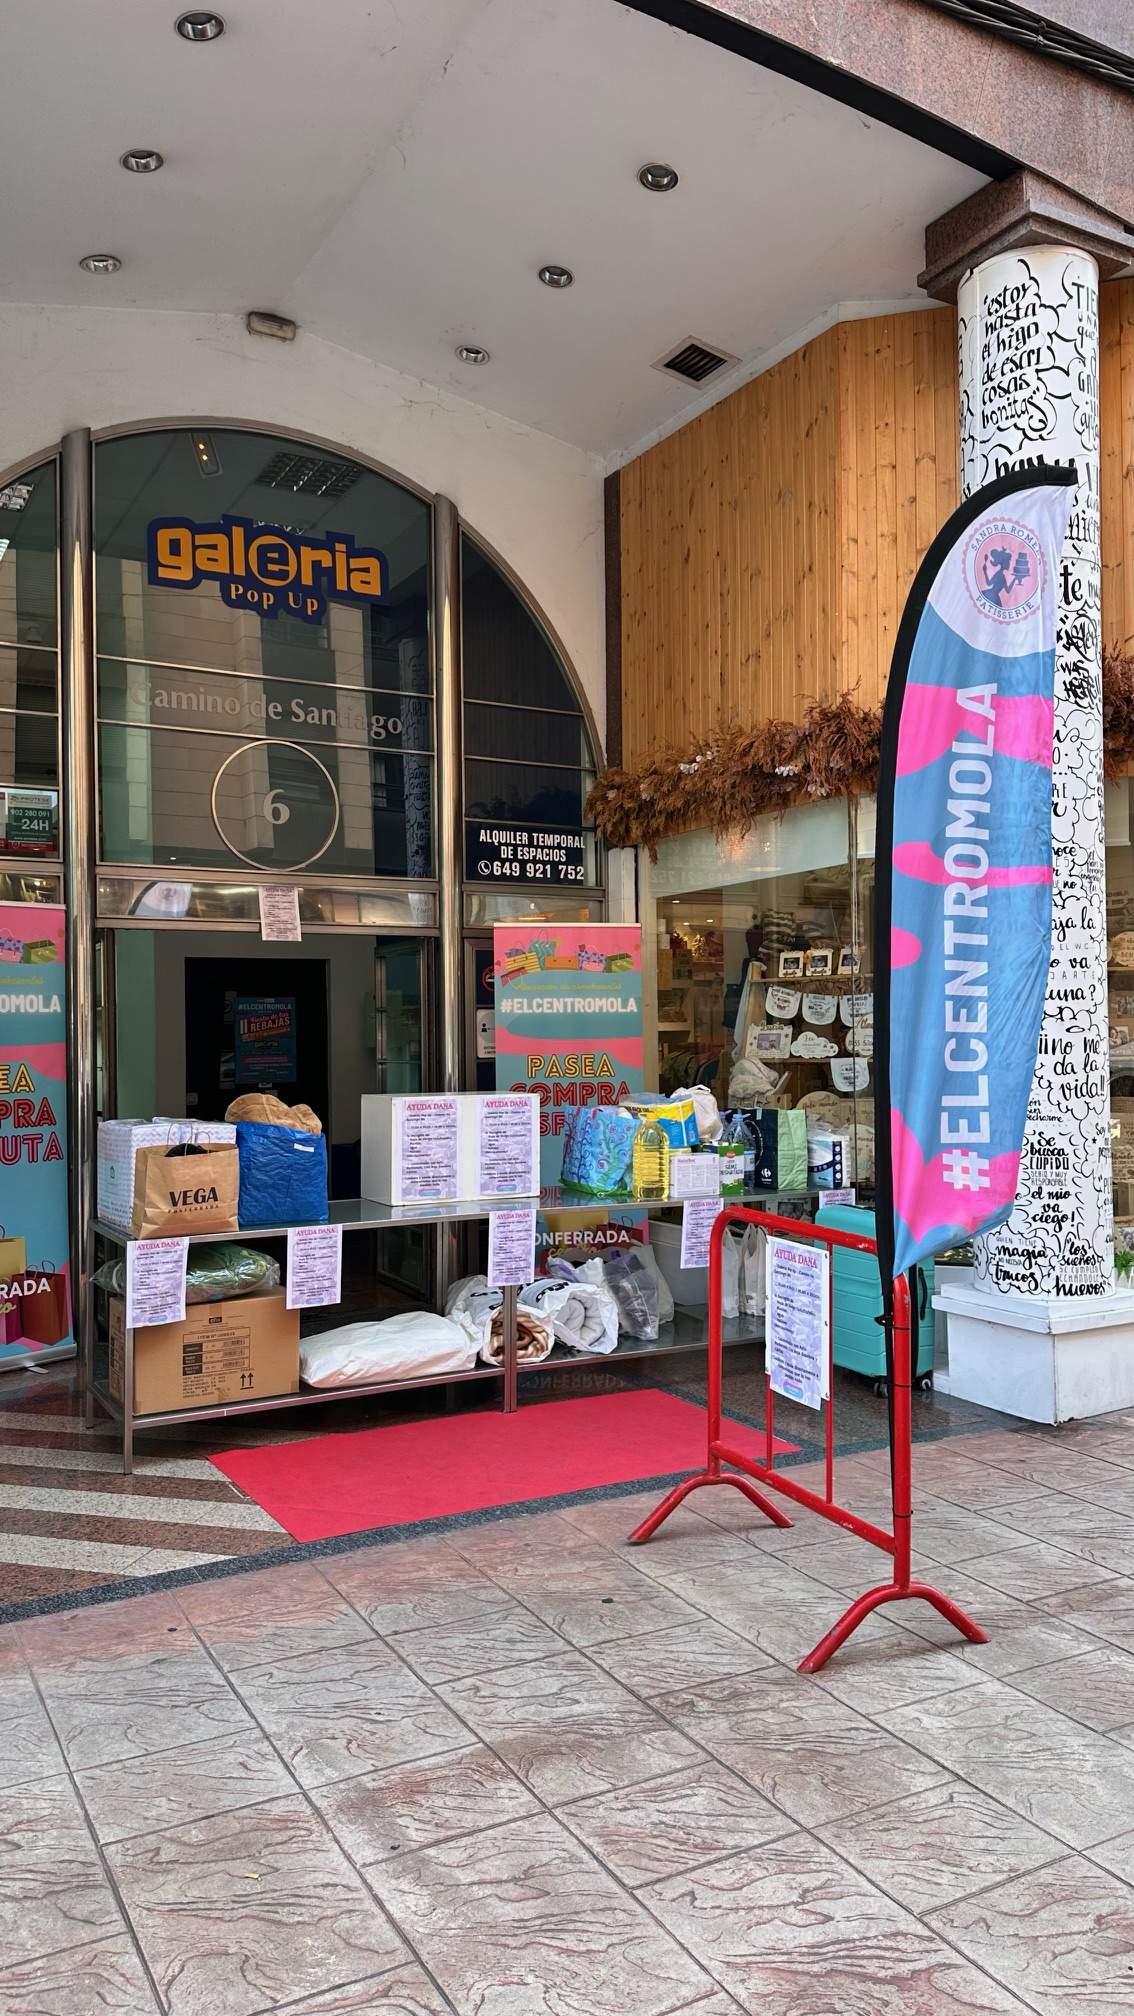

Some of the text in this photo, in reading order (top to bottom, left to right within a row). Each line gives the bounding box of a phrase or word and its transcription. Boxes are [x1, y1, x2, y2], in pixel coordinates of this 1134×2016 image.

[985, 302, 1037, 338] hasta
[982, 321, 1040, 363] el higo
[982, 361, 998, 385] de
[982, 372, 1031, 406] cosas
[970, 523, 1007, 551] SANDRA
[156, 526, 381, 597] galeria
[230, 583, 318, 616] Pop Up
[976, 595, 1034, 620] PATISSERIE
[133, 681, 402, 740] Camino de Santiago
[263, 788, 291, 825] 6
[21, 818, 49, 831] 24H
[479, 829, 586, 849] ALQUILER TEMPORAL
[500, 845, 567, 862] DE ESPACIOS
[493, 861, 585, 880] 649 921 752
[1080, 906, 1096, 930] la
[940, 682, 998, 1193] #ELCENTROMOLA
[1069, 957, 1090, 969] va
[500, 997, 638, 1014] #ELCENTROMOLA
[250, 1016, 291, 1033] REBAJAS
[1083, 1036, 1101, 1055] me
[527, 1053, 616, 1079] PASEA
[1053, 1052, 1099, 1076] da la
[407, 1103, 432, 1111] AYUDA
[485, 1100, 528, 1109] AYUDA DANA
[1030, 1142, 1069, 1157] busca
[1037, 1131, 1056, 1147] Se
[169, 1186, 219, 1208] VEGA
[1031, 1186, 1045, 1201] el
[1042, 1202, 1063, 1214] va
[1031, 1210, 1075, 1234] ciego!
[137, 1243, 161, 1251] AYUDA
[535, 1229, 630, 1246] ONFERRADA
[774, 1248, 817, 1269] AYUDA DANA
[995, 1244, 1049, 1271] magia
[992, 1260, 1039, 1292] trucos
